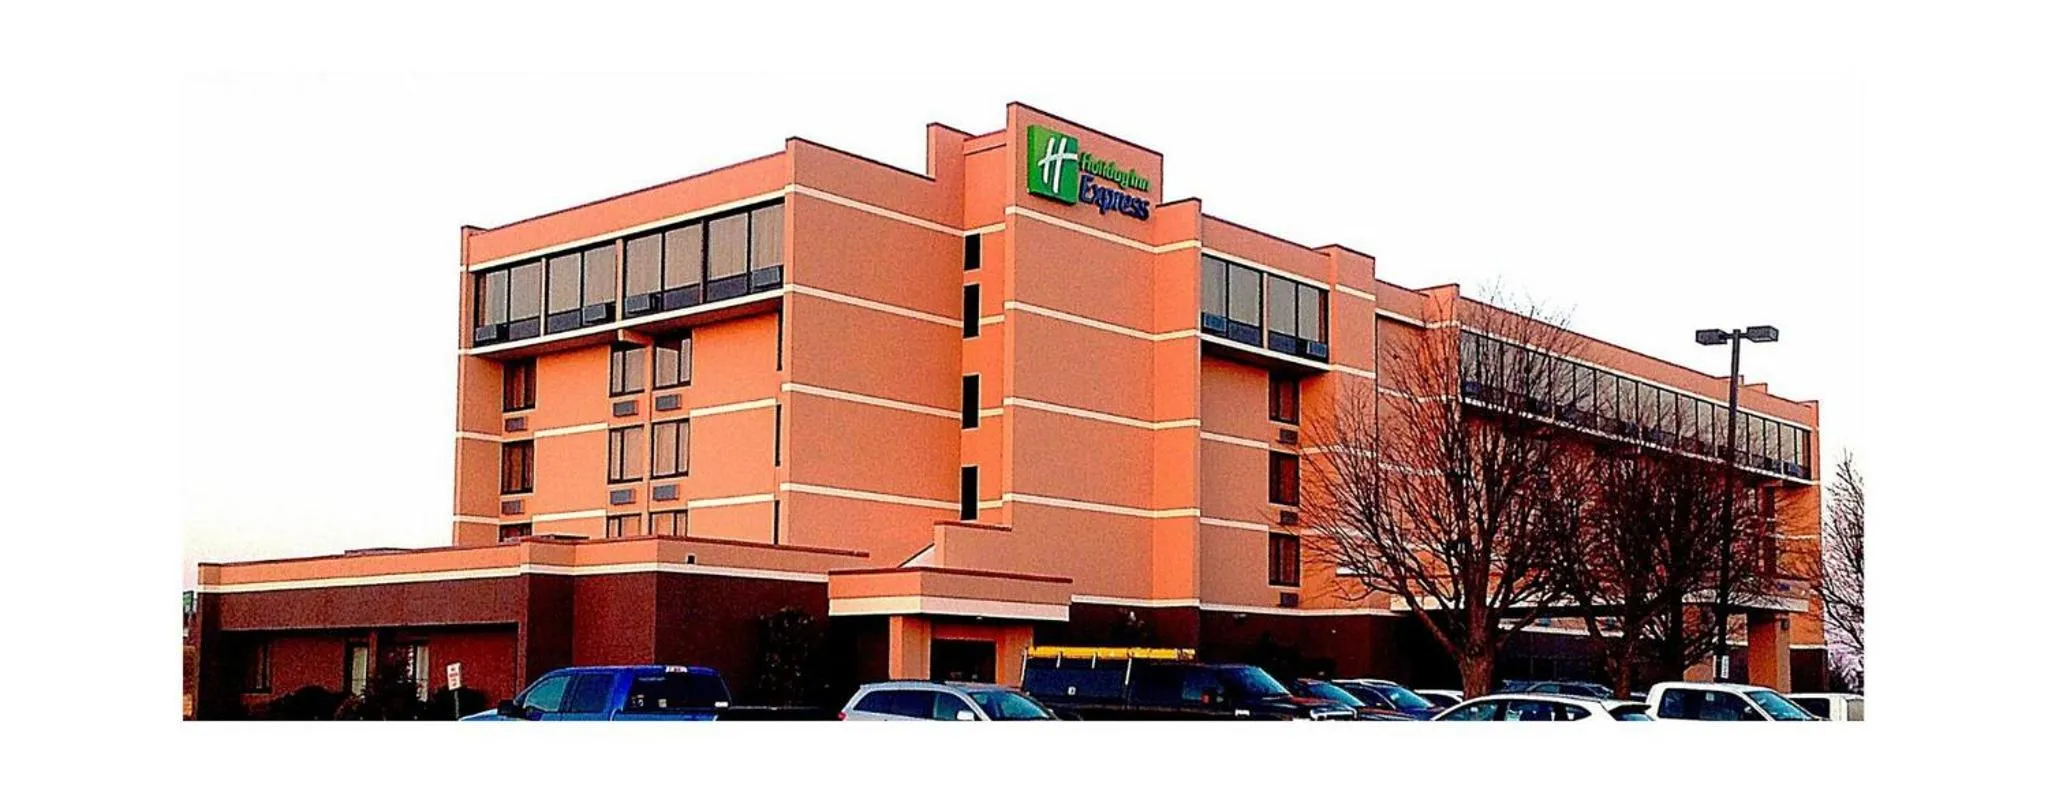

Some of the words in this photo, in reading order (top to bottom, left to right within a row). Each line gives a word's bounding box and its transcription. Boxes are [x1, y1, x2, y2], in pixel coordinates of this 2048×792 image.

[1038, 137, 1078, 194] H
[1080, 152, 1129, 188] Holiday
[1079, 175, 1150, 221] Express
